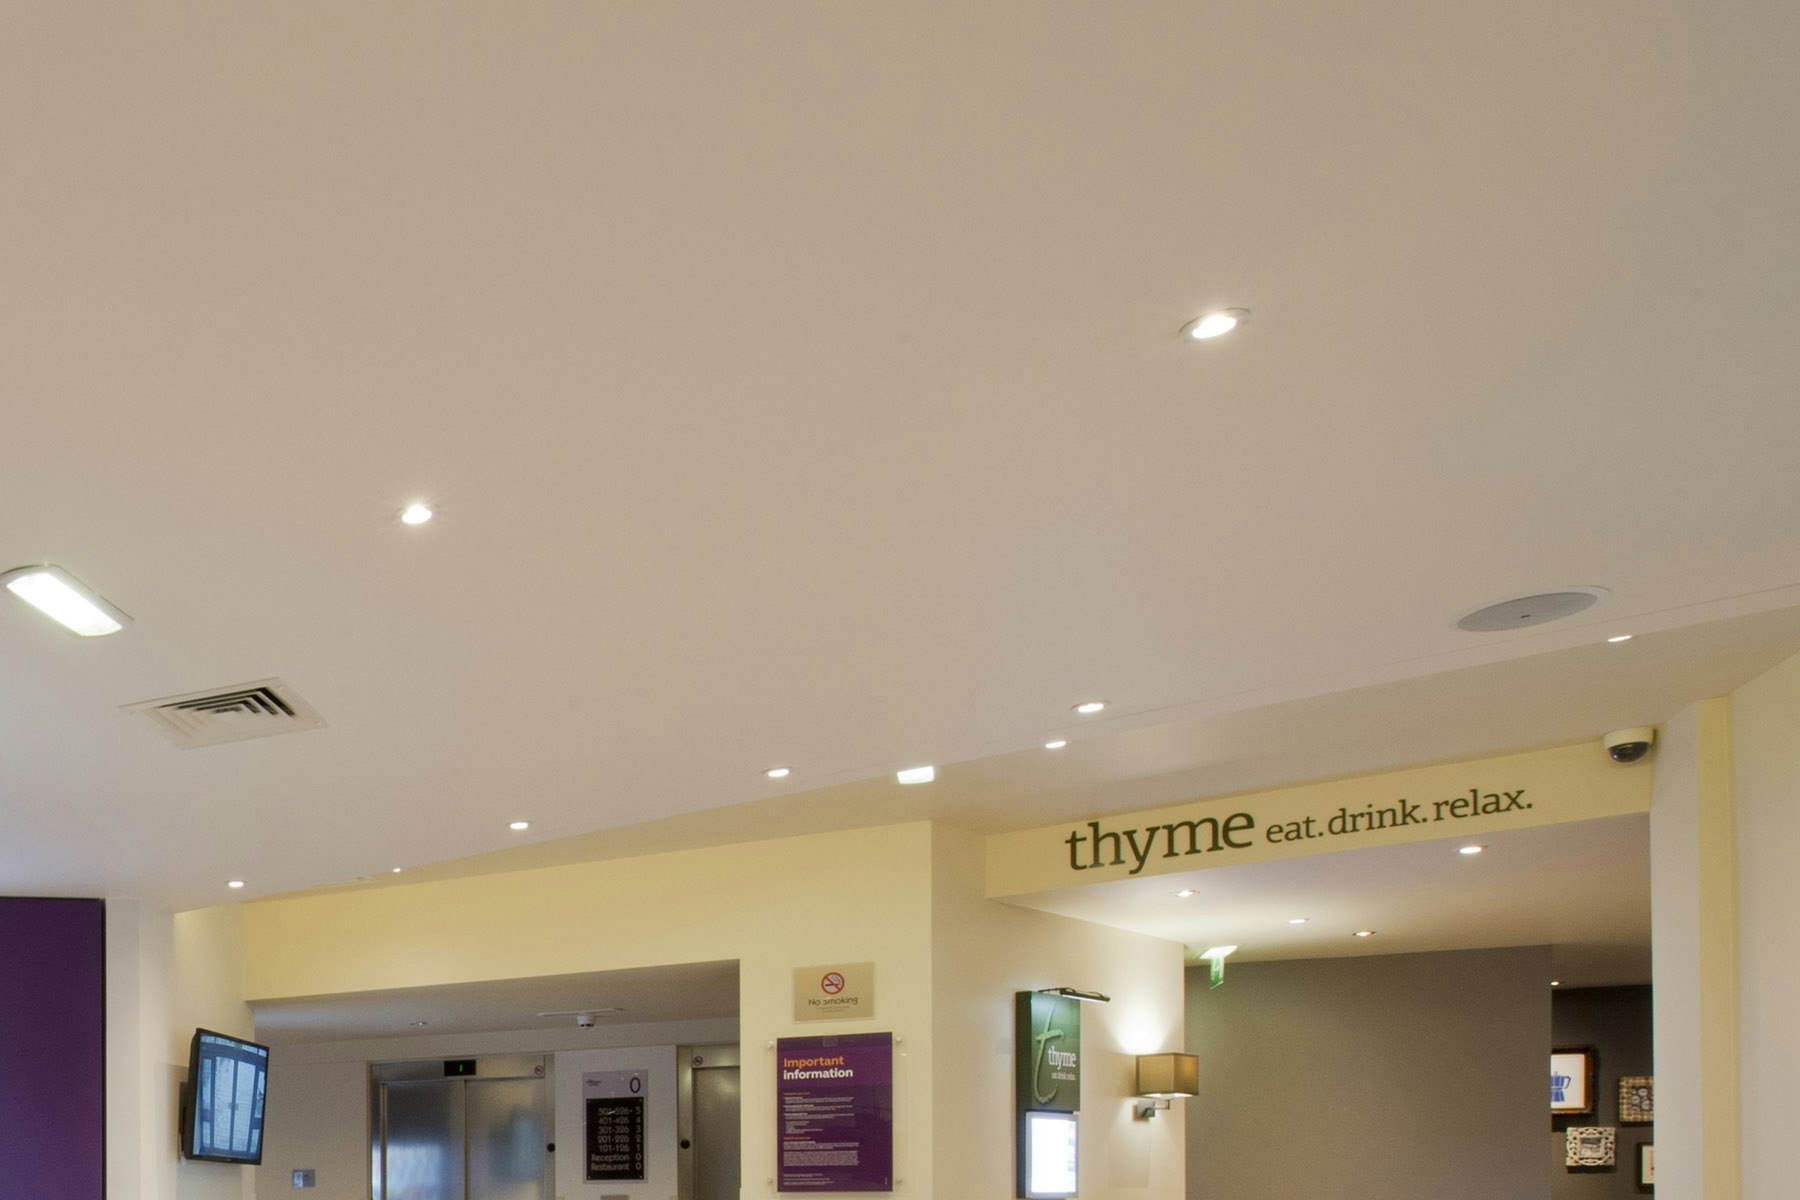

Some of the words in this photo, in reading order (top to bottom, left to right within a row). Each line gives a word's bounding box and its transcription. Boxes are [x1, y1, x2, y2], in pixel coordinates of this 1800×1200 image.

[1065, 809, 1255, 875] thyme
[808, 998, 821, 1006] No
[783, 1056, 845, 1068] Important
[1048, 1045, 1077, 1070] thyme
[783, 1068, 854, 1080] information
[629, 1076, 641, 1094] 0
[635, 1125, 641, 1133] 3
[591, 1153, 630, 1163] Reception
[590, 1163, 630, 1171] Restaurant
